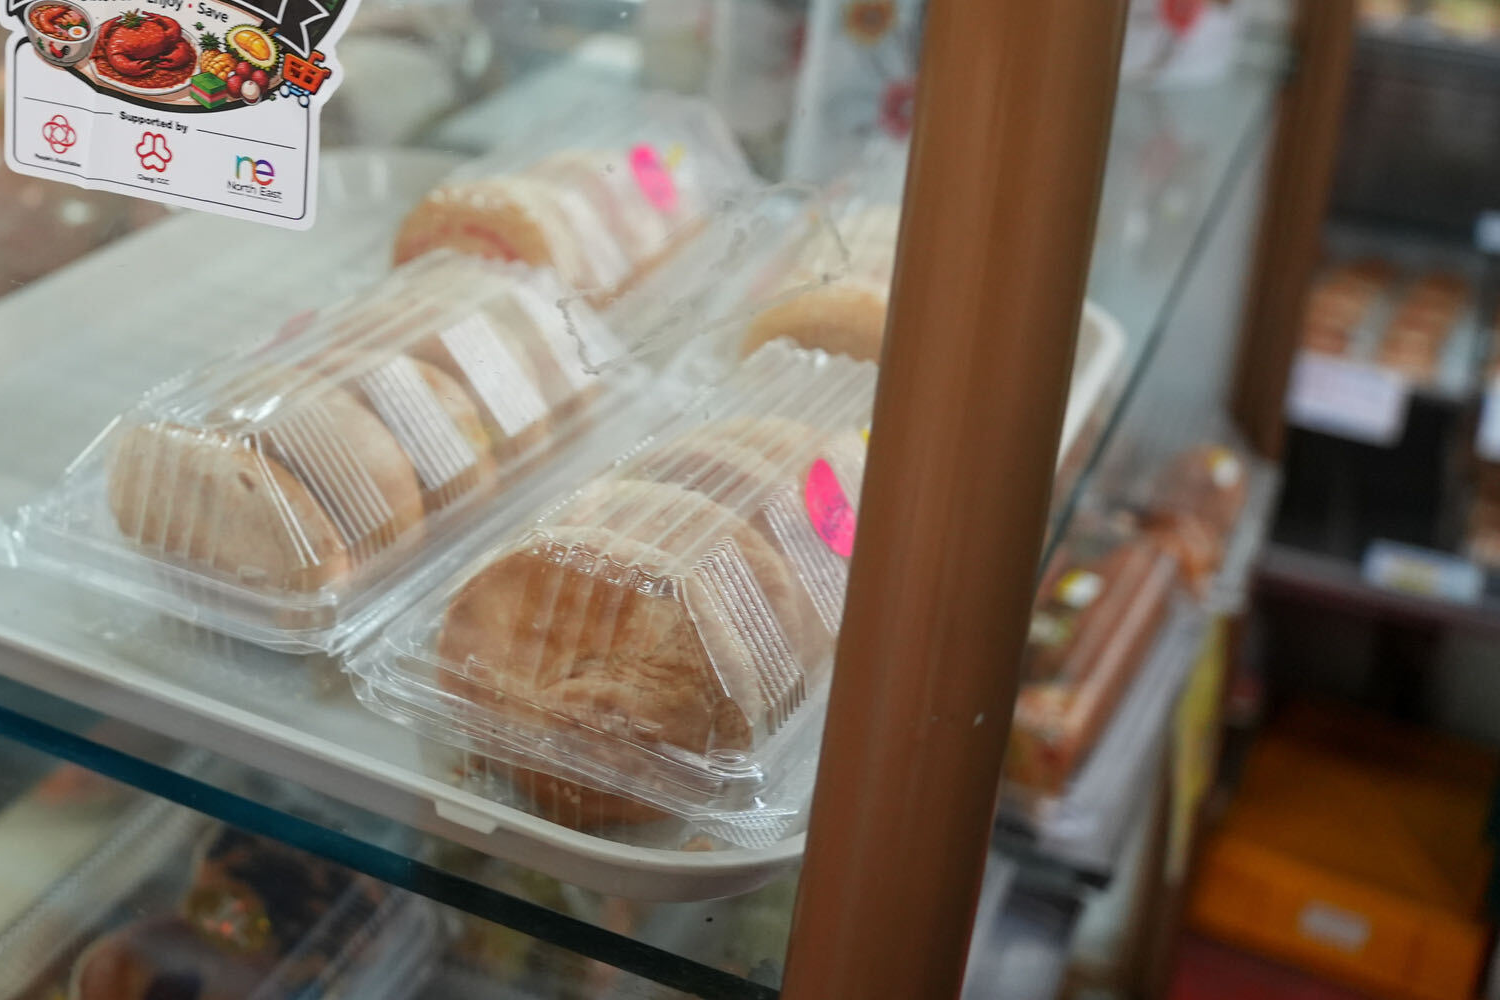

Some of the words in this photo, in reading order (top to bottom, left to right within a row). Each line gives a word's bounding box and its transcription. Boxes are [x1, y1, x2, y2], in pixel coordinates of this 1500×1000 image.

[197, 1, 230, 23] Save
[119, 110, 173, 130] Supported
[175, 120, 189, 134] by
[226, 180, 257, 196] North
[259, 186, 283, 201] East
